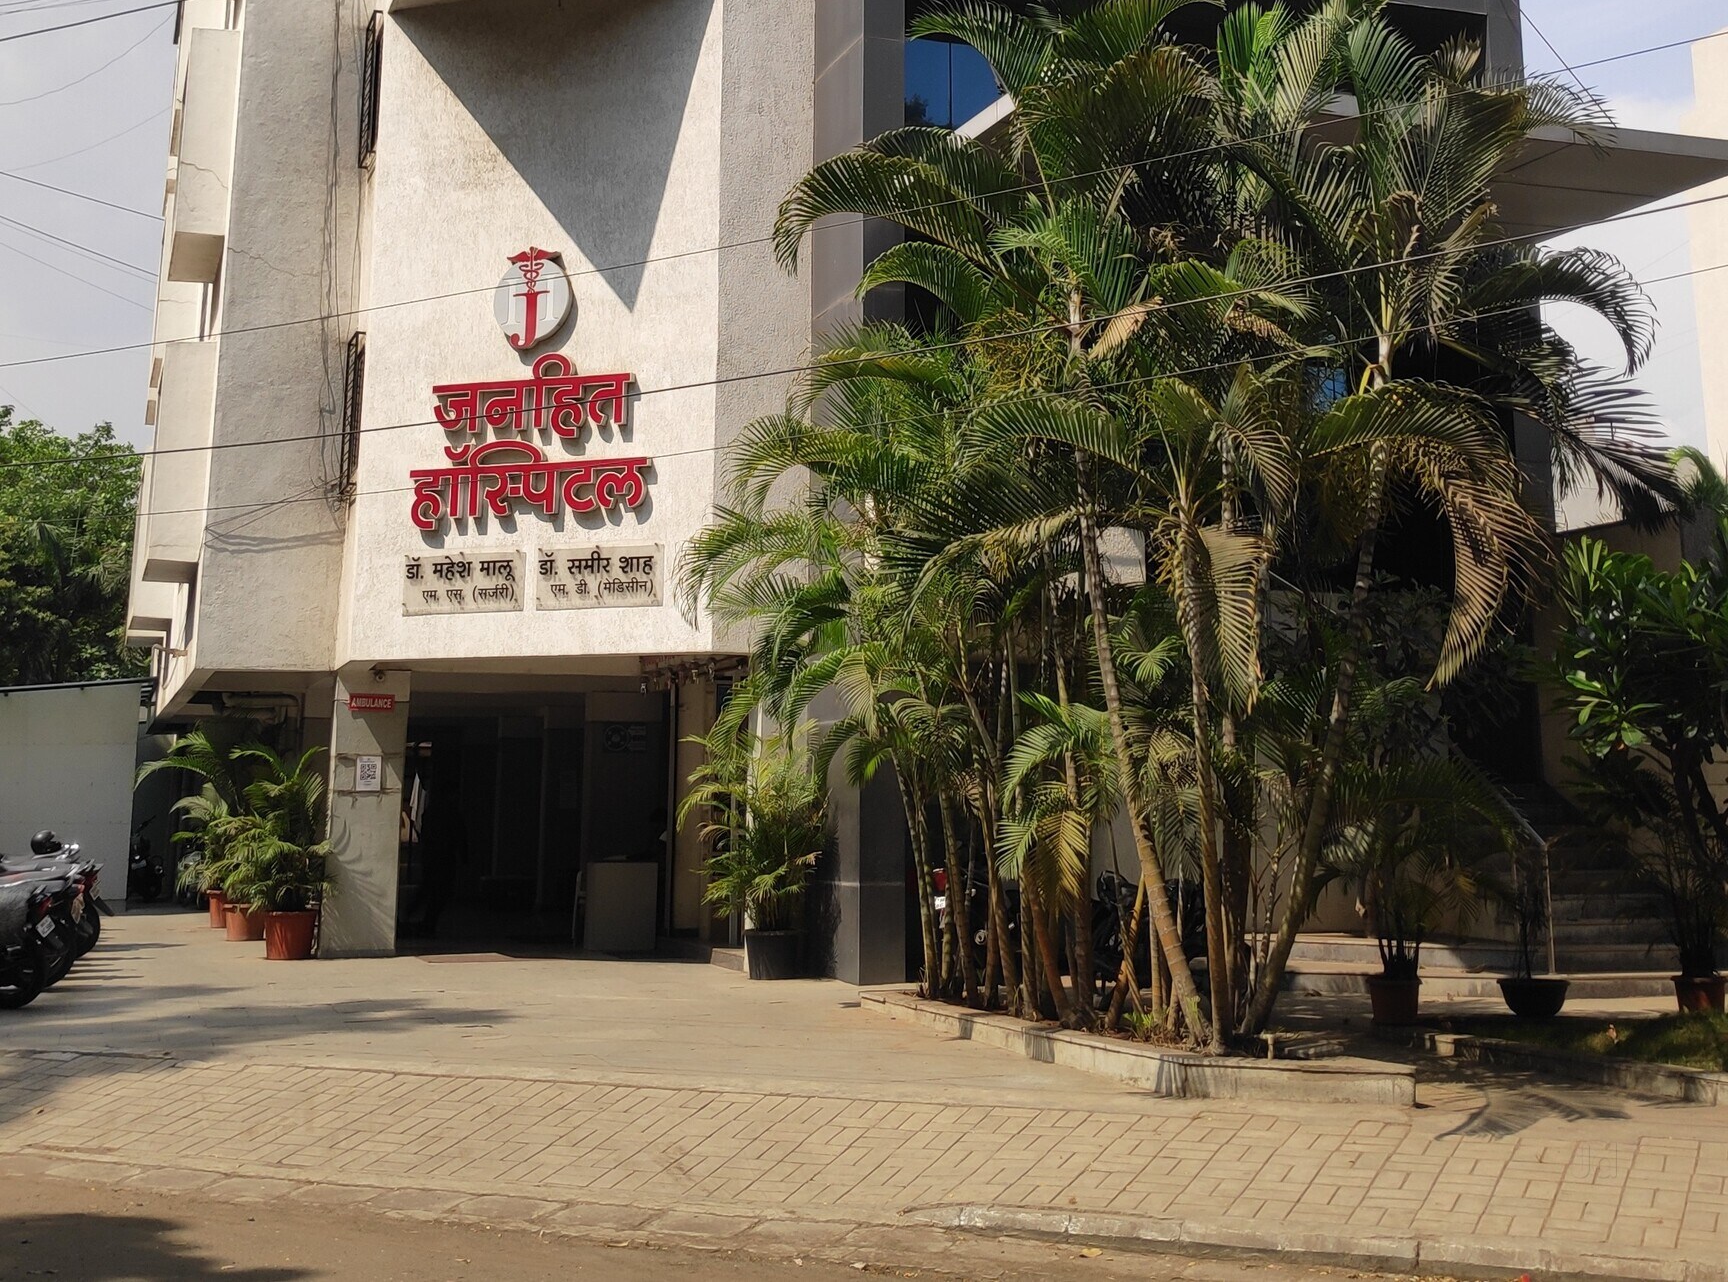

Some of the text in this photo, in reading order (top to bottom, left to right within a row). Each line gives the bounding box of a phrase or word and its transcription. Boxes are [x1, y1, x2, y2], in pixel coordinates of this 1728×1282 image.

[432, 353, 634, 438] जनहित
[409, 440, 651, 530] हॉस्पिटल
[405, 556, 516, 583] डॉ. महेश मालू
[538, 551, 654, 576] डॉ. समीर शाह
[422, 589, 439, 602] एम.
[472, 585, 515, 603] (सर्जरी)
[550, 578, 654, 597] एम. डी. (मेडिसीन)
[350, 698, 392, 708] AMBULANCE
